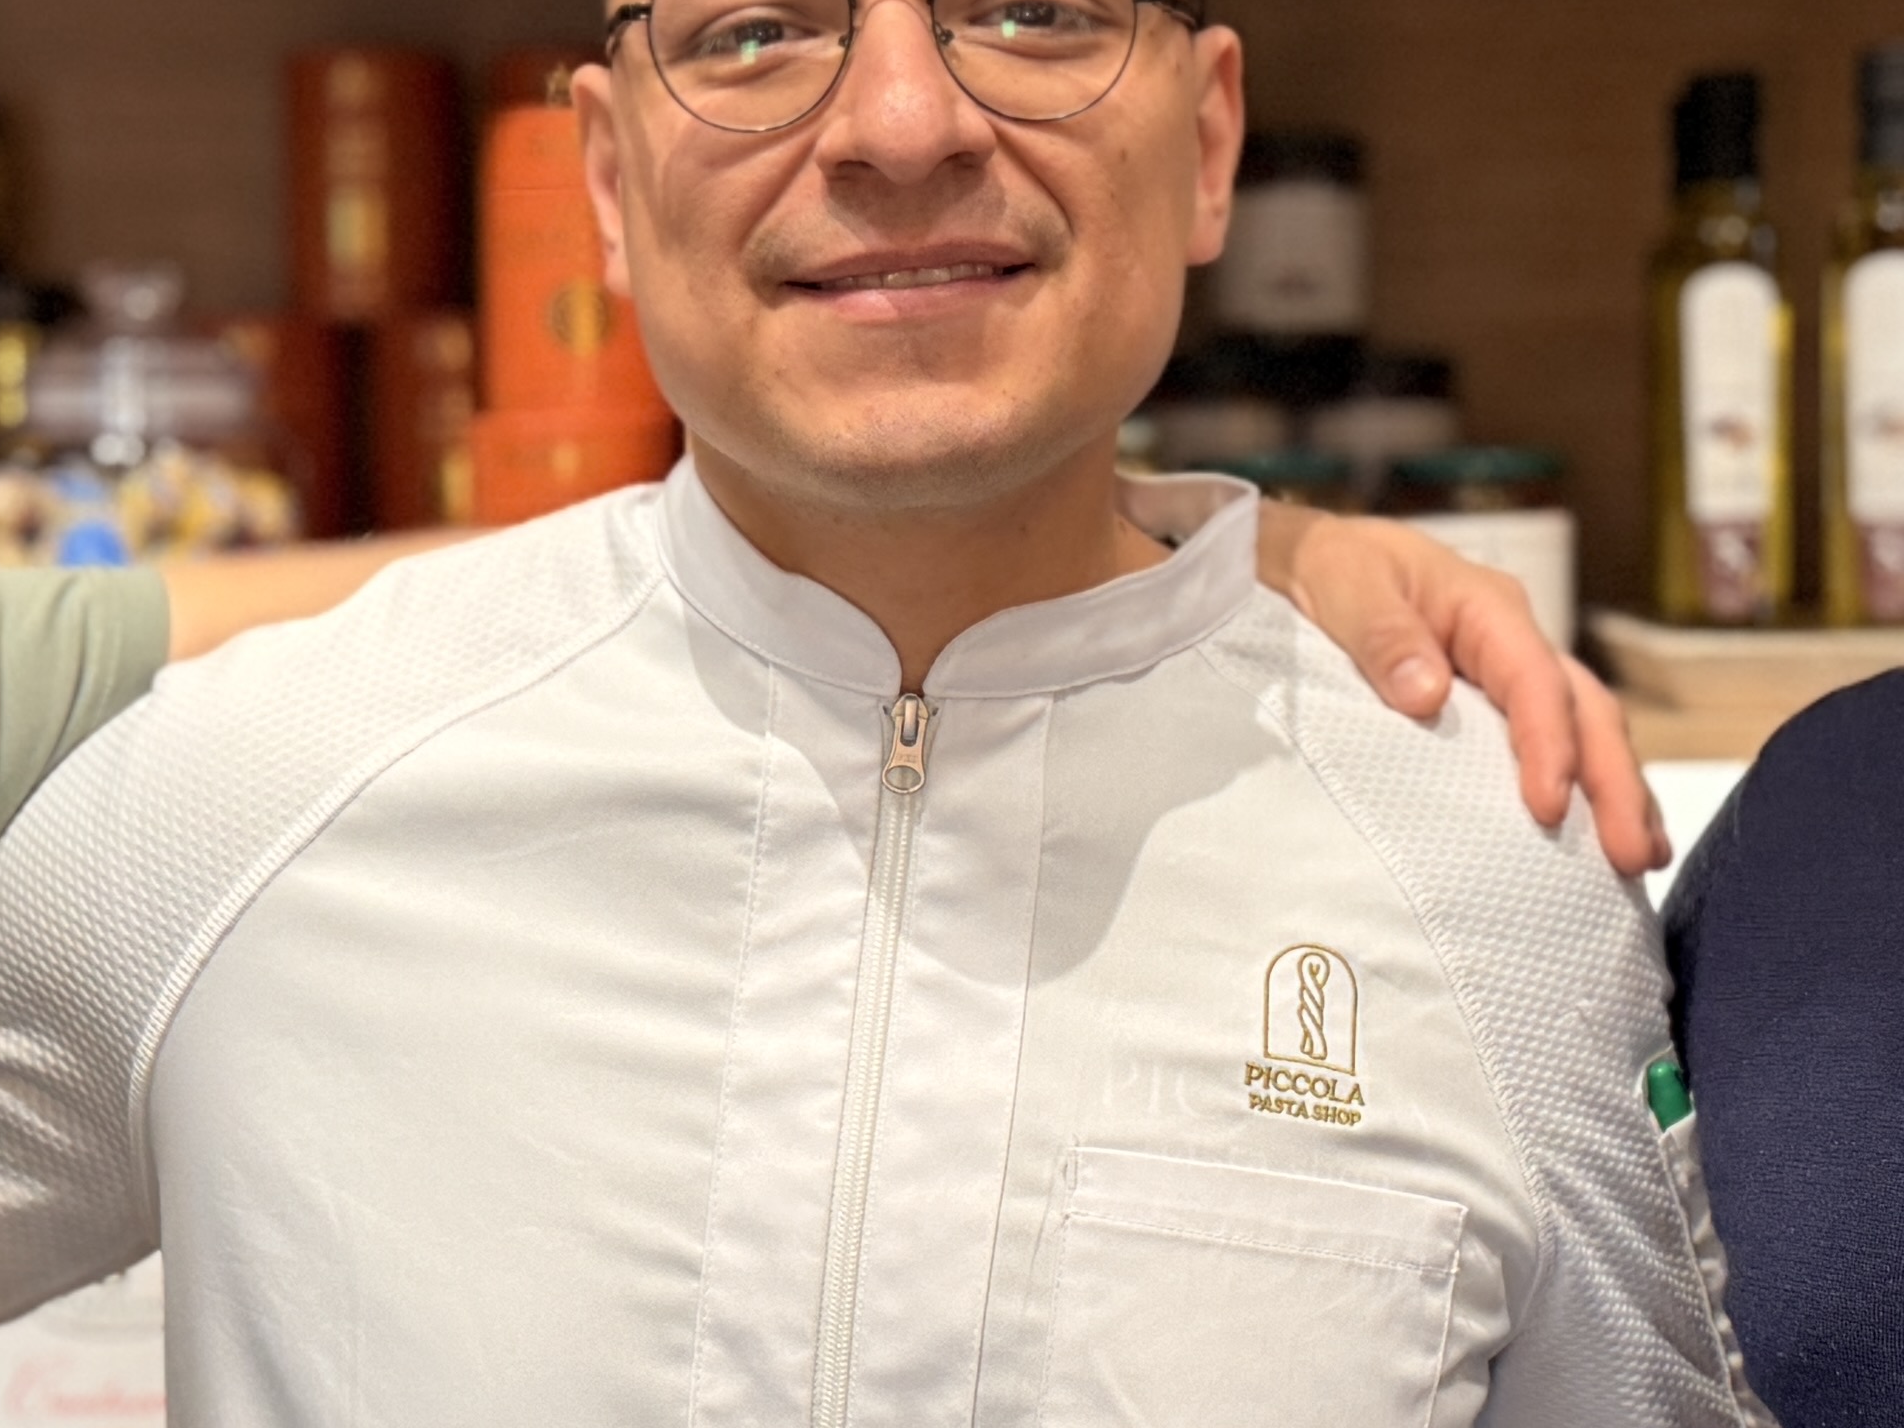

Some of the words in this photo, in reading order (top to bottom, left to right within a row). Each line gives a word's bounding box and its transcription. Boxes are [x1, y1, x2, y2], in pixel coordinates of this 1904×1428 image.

[1243, 1060, 1366, 1106] PICCOLA
[1249, 1093, 1308, 1120] PASTA
[1313, 1106, 1361, 1126] SHOP
